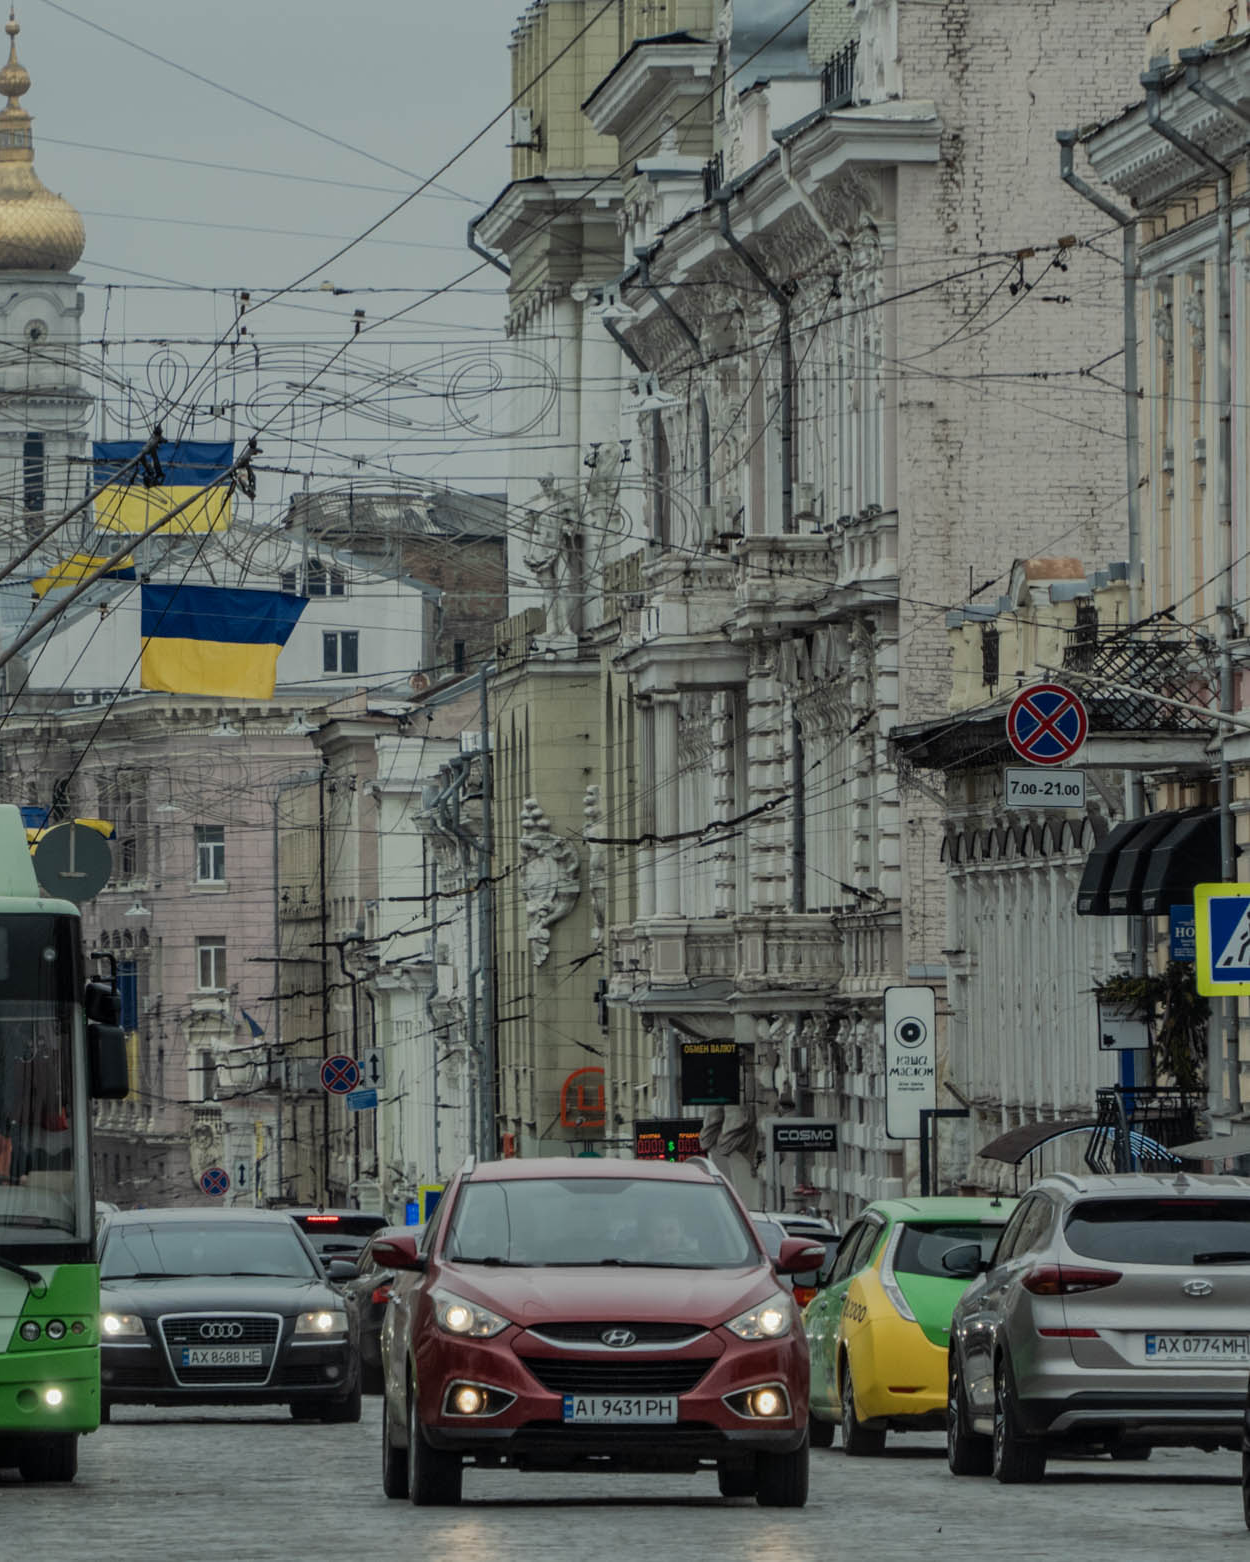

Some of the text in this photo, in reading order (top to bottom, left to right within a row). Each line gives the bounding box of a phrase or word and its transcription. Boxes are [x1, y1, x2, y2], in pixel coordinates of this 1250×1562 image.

[1010, 781, 1080, 796] 7.00-21.00
[777, 1129, 833, 1141] COSMO
[1182, 1338, 1220, 1353] 0774
[602, 1399, 642, 1416] 9431
